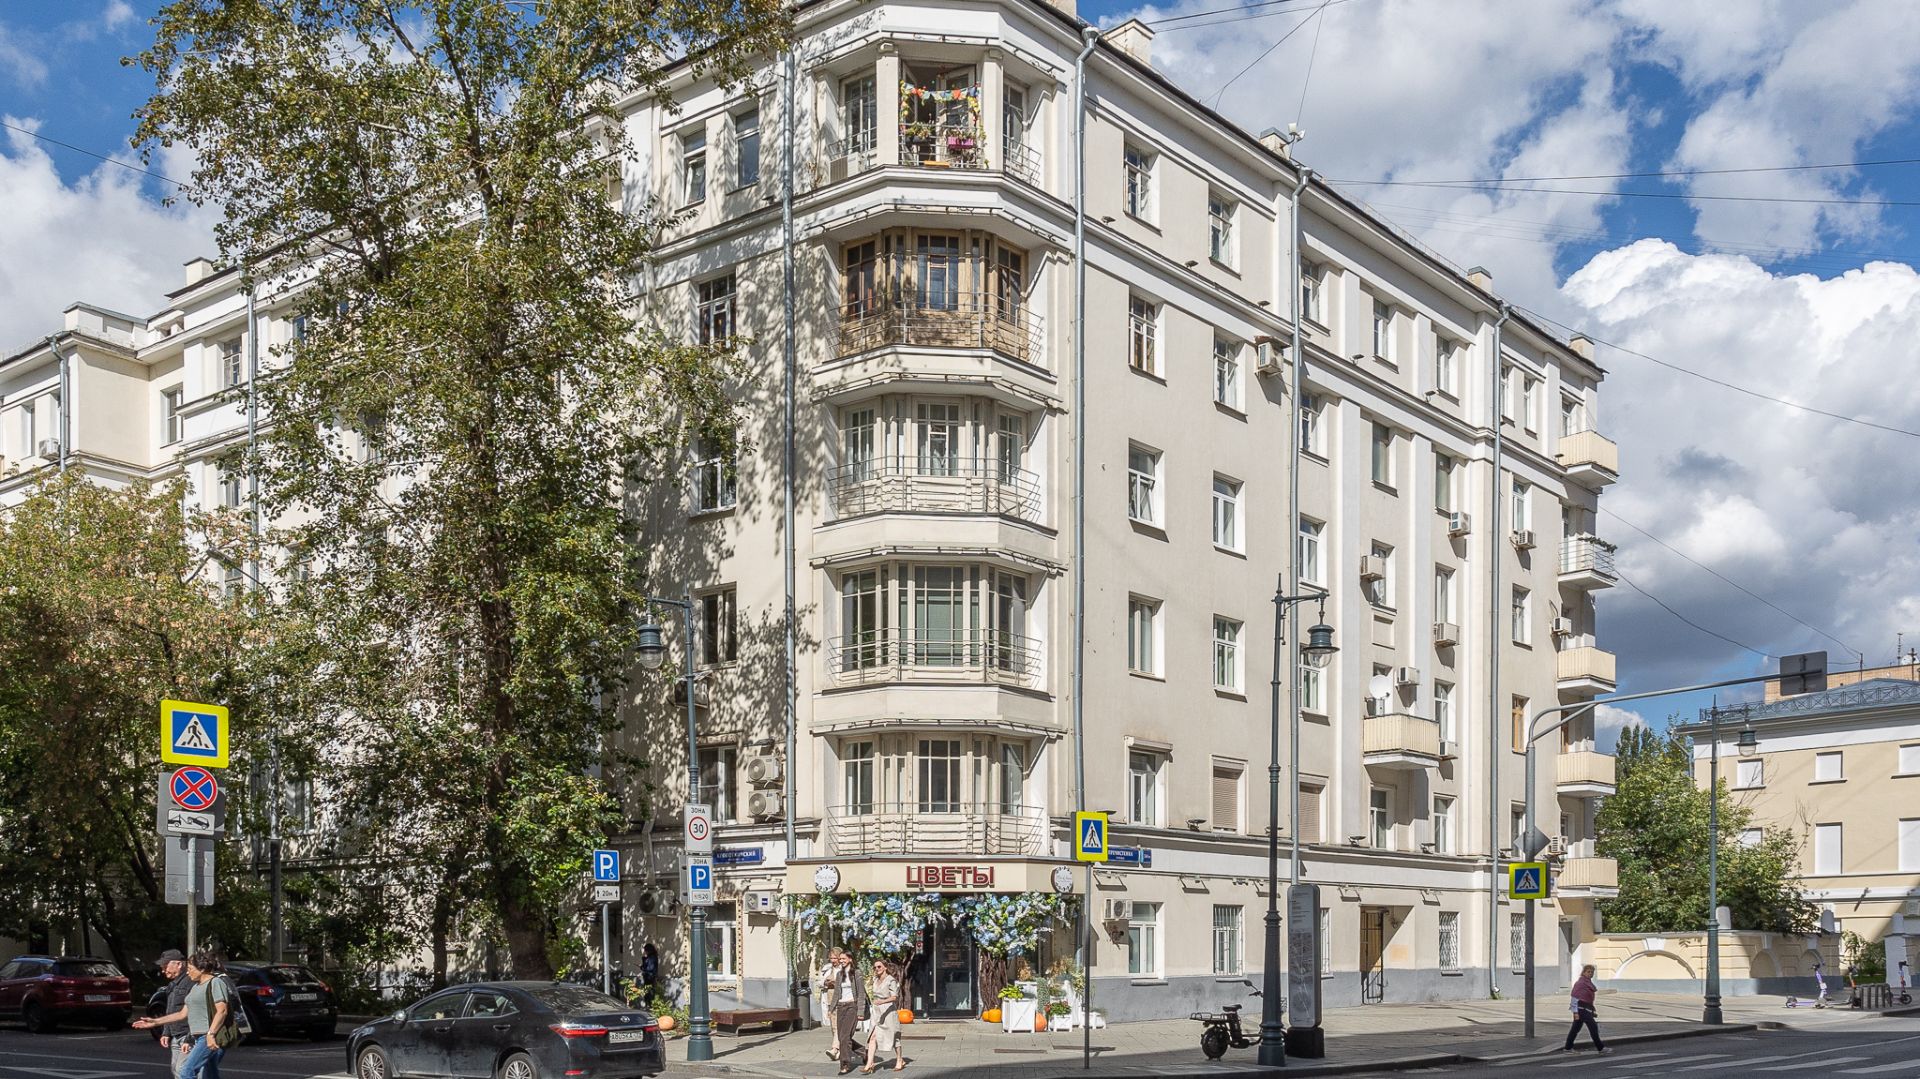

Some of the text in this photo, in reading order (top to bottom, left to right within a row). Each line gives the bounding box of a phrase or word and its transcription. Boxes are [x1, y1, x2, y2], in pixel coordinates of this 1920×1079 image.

[693, 823, 704, 834] 30
[600, 853, 614, 878] P
[695, 868, 707, 887] P
[906, 865, 995, 888] ЦВЕТЫ
